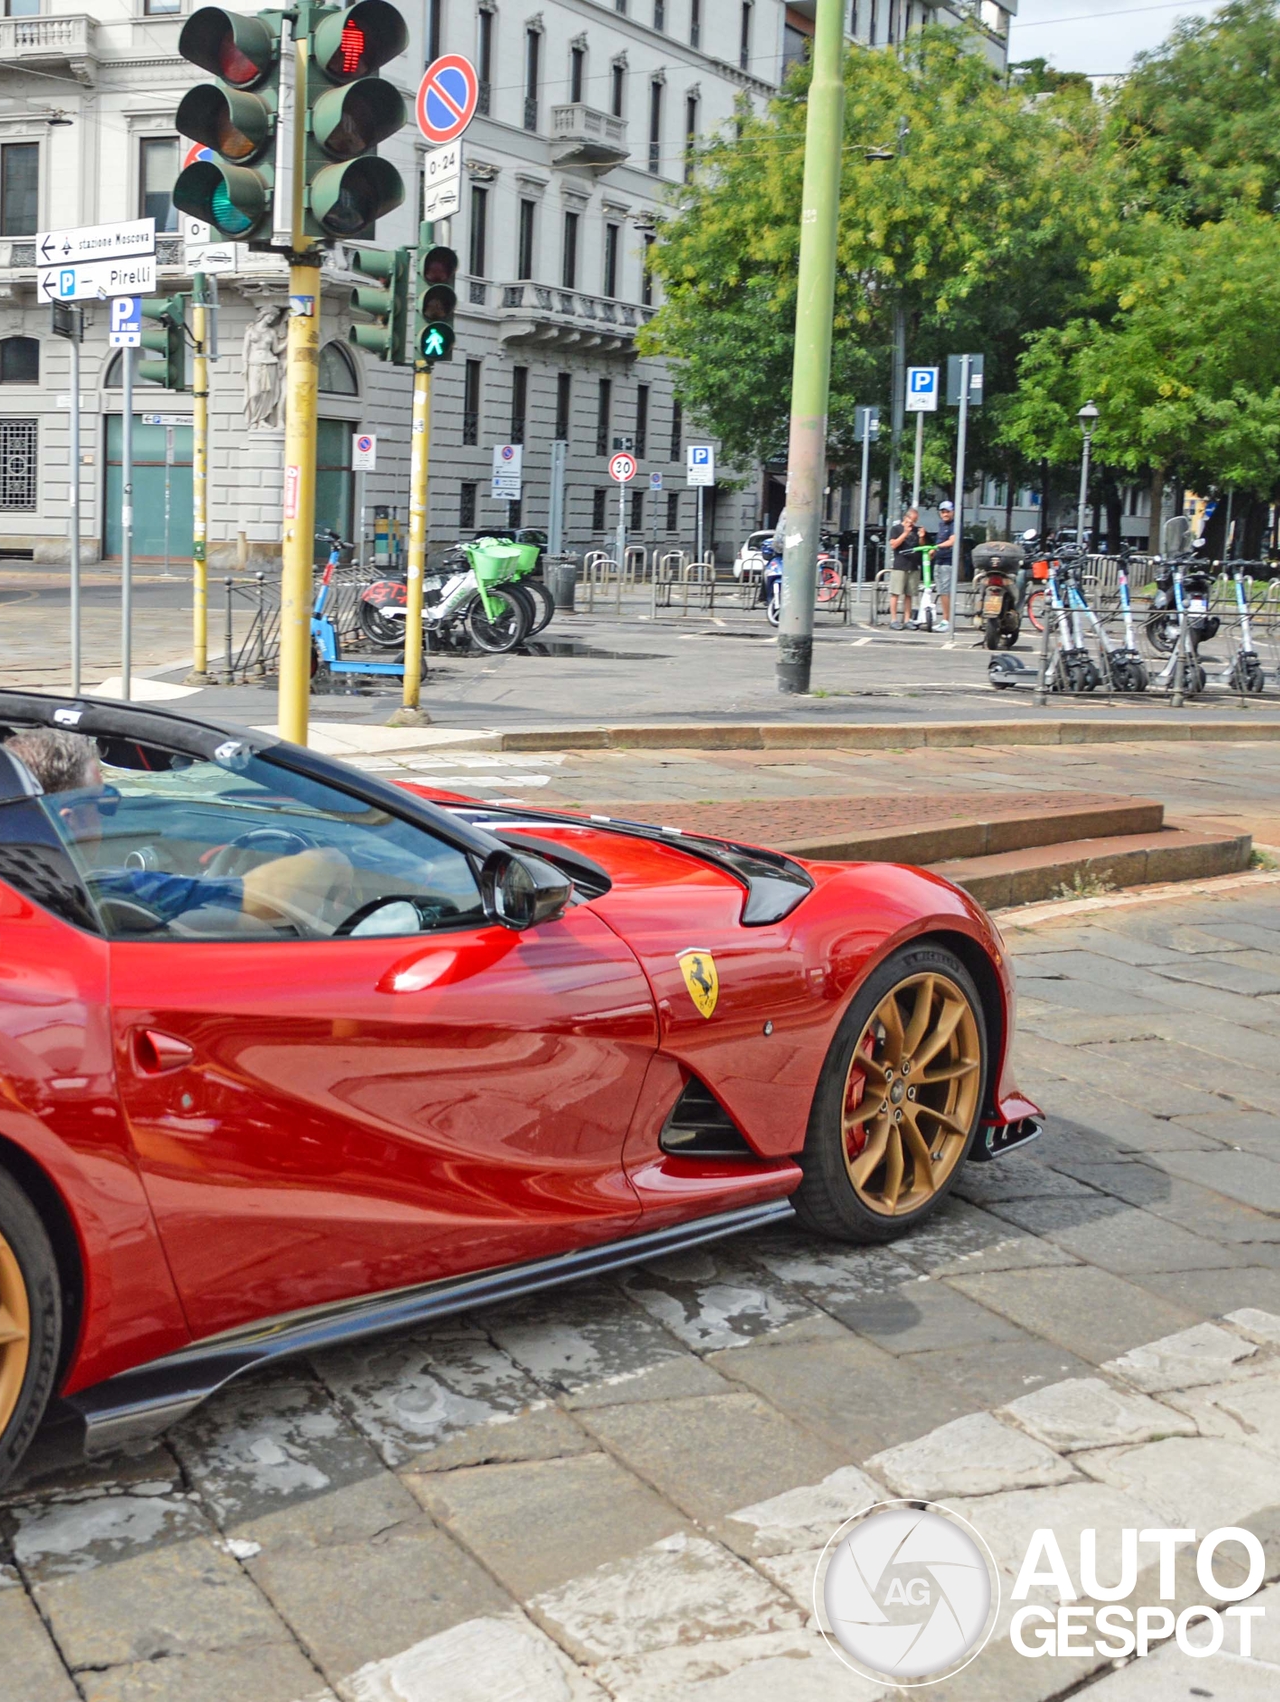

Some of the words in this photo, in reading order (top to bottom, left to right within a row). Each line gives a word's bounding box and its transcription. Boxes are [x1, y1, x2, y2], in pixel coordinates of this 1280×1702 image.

[78, 236, 112, 250] stazione
[115, 232, 150, 246] Moscova
[110, 266, 151, 286] Pirelli
[915, 372, 932, 391] P
[695, 449, 708, 463] P
[615, 461, 631, 474] 30
